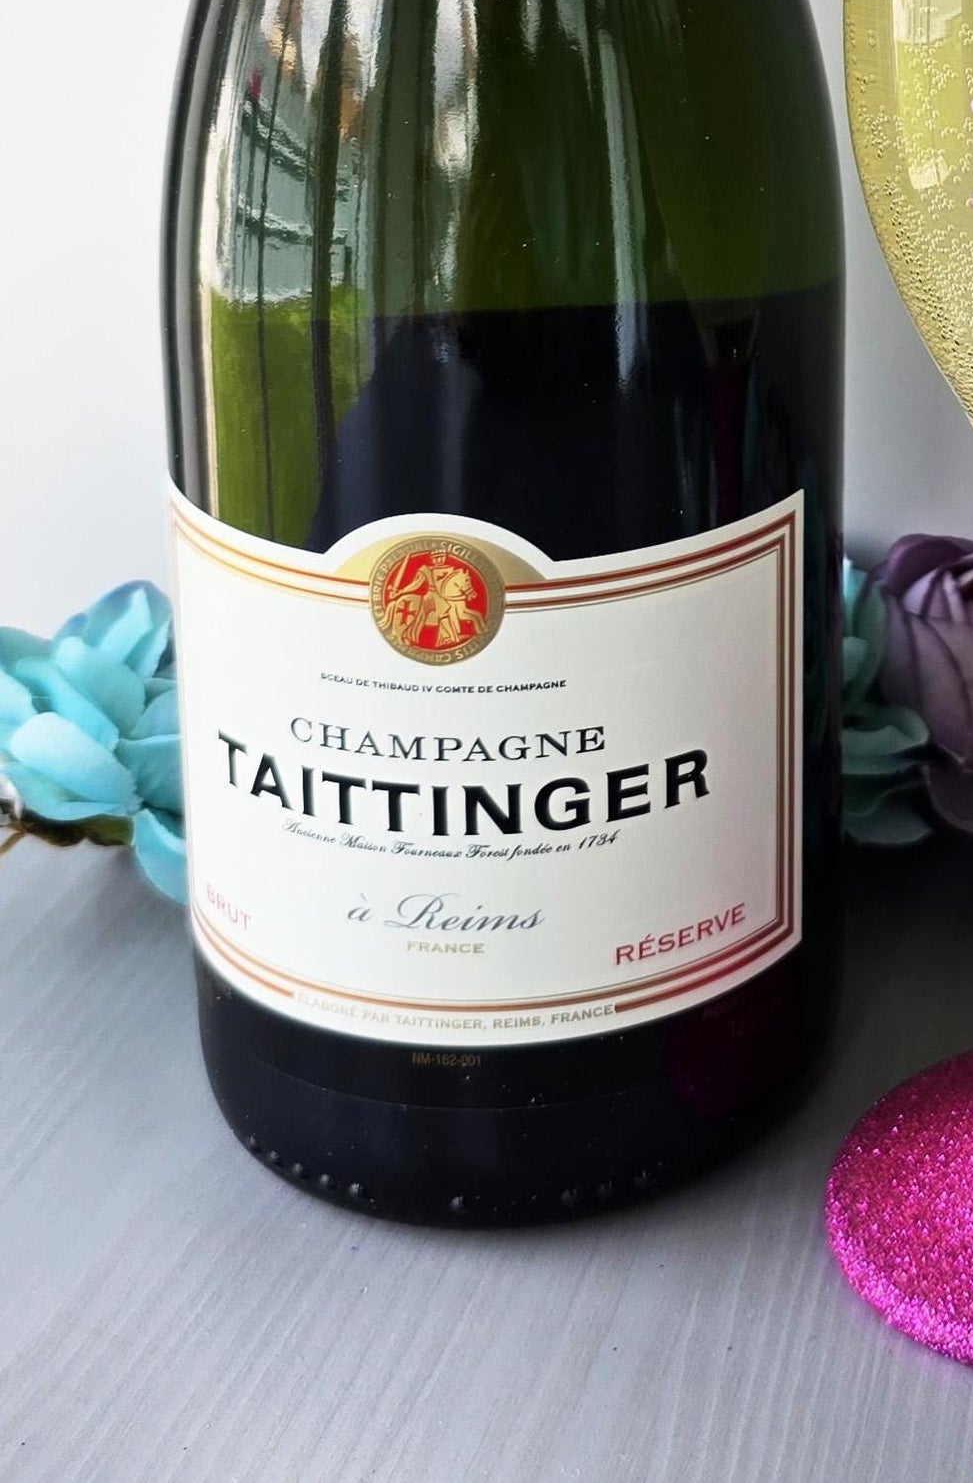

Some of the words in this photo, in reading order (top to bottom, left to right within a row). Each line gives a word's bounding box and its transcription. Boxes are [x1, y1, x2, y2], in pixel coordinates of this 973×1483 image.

[356, 678, 370, 687] DE
[373, 680, 419, 692] THIBAUD
[423, 685, 433, 693] IV
[436, 685, 475, 693] COMTE
[478, 685, 493, 693] DE
[496, 679, 567, 693] CHAMPAGNE
[290, 717, 606, 763] CHAMPAGNE
[217, 729, 711, 836] TAITTINGER
[283, 818, 336, 844] Ancienne
[340, 832, 387, 853] Maison
[556, 844, 570, 852] en
[206, 882, 252, 932] BRUT
[347, 892, 372, 922] à
[383, 892, 545, 932] Reims
[406, 940, 486, 954] FRANCE
[615, 902, 746, 965] RÉSERVE
[362, 1008, 390, 1024] PAR
[551, 1003, 614, 1026] FRANCE
